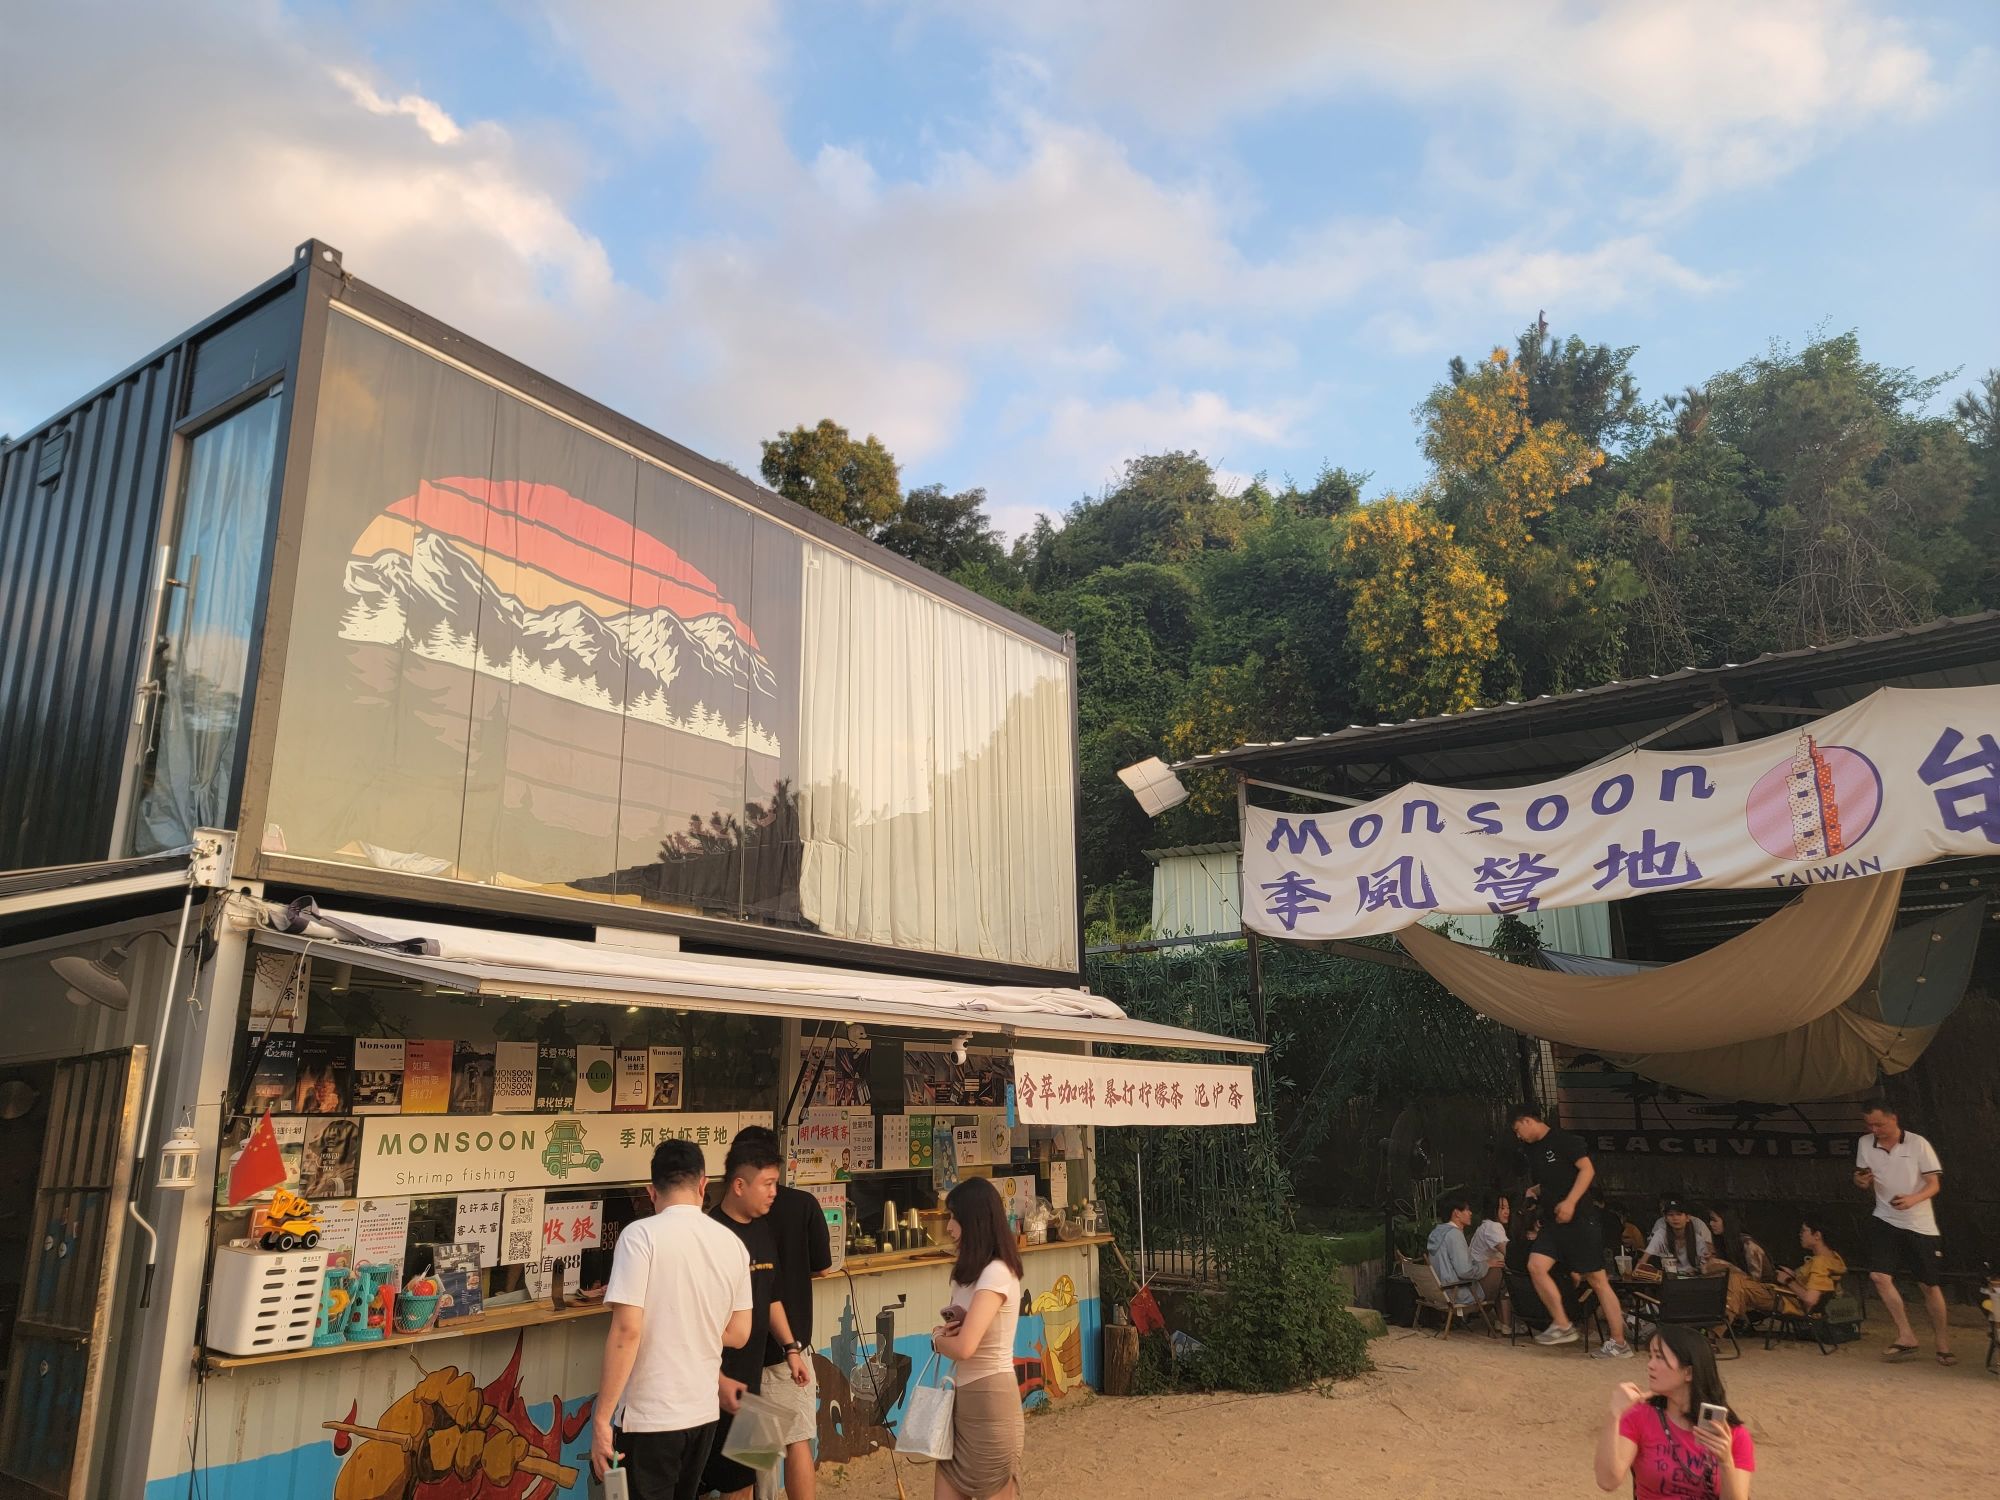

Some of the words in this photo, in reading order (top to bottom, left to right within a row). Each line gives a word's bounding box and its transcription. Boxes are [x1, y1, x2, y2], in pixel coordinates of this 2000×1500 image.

[1266, 765, 1717, 856] Monsoon
[1260, 829, 1703, 931] 季風營地
[1771, 856, 1881, 886] TAIWAN
[412, 1061, 431, 1070] 如果
[496, 1069, 533, 1077] MONSOON
[537, 1097, 573, 1108] 绿化世界
[1018, 1072, 1096, 1110] 冷萃咖啡
[377, 1131, 535, 1155] MONSOON
[620, 1126, 728, 1149] 季风钓虾营地
[957, 1129, 978, 1139] 自助区
[396, 1171, 454, 1185] Shrimp
[463, 1168, 516, 1183] fishing
[544, 1216, 597, 1244] 收銀
